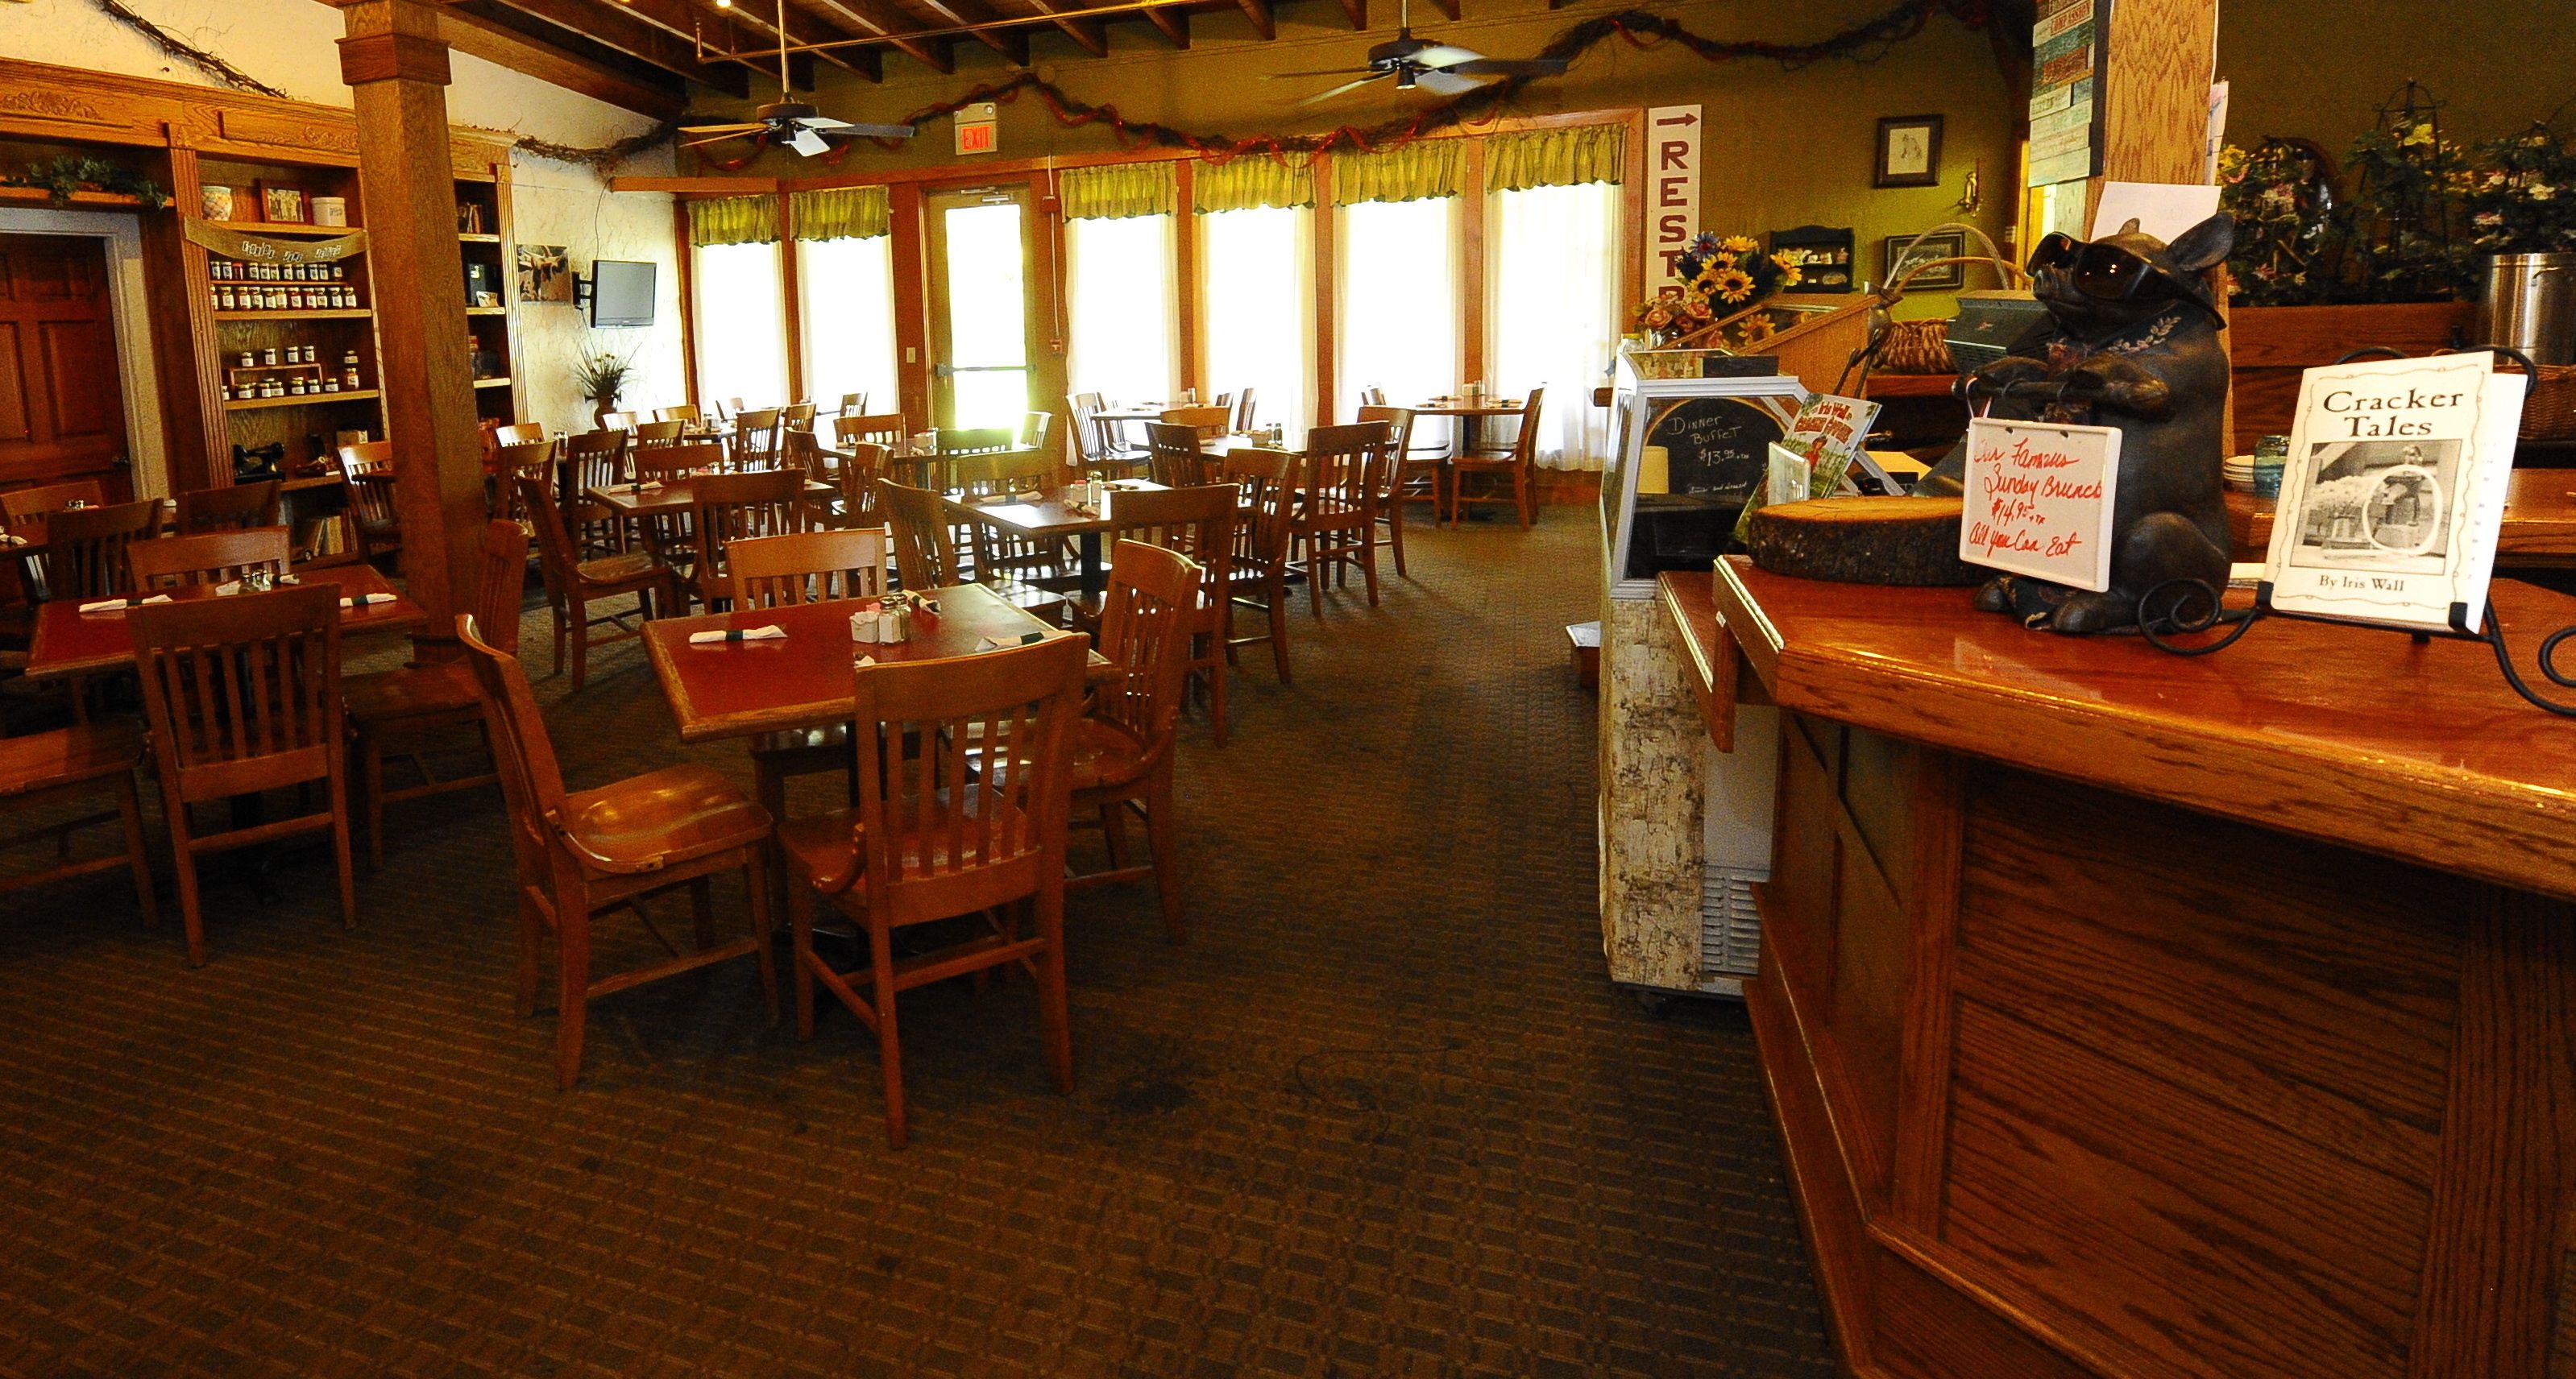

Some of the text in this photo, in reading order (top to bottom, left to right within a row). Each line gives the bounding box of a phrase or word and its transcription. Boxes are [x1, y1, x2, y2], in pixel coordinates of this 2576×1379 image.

[961, 126, 992, 151] EXIT
[2323, 387, 2463, 412] Cracker
[2344, 415, 2433, 437] Tales
[2011, 437, 2080, 469] Famous
[1984, 463, 2039, 505] Sunday
[2045, 532, 2082, 557] Eat
[2319, 574, 2404, 591] By Iris Wall
